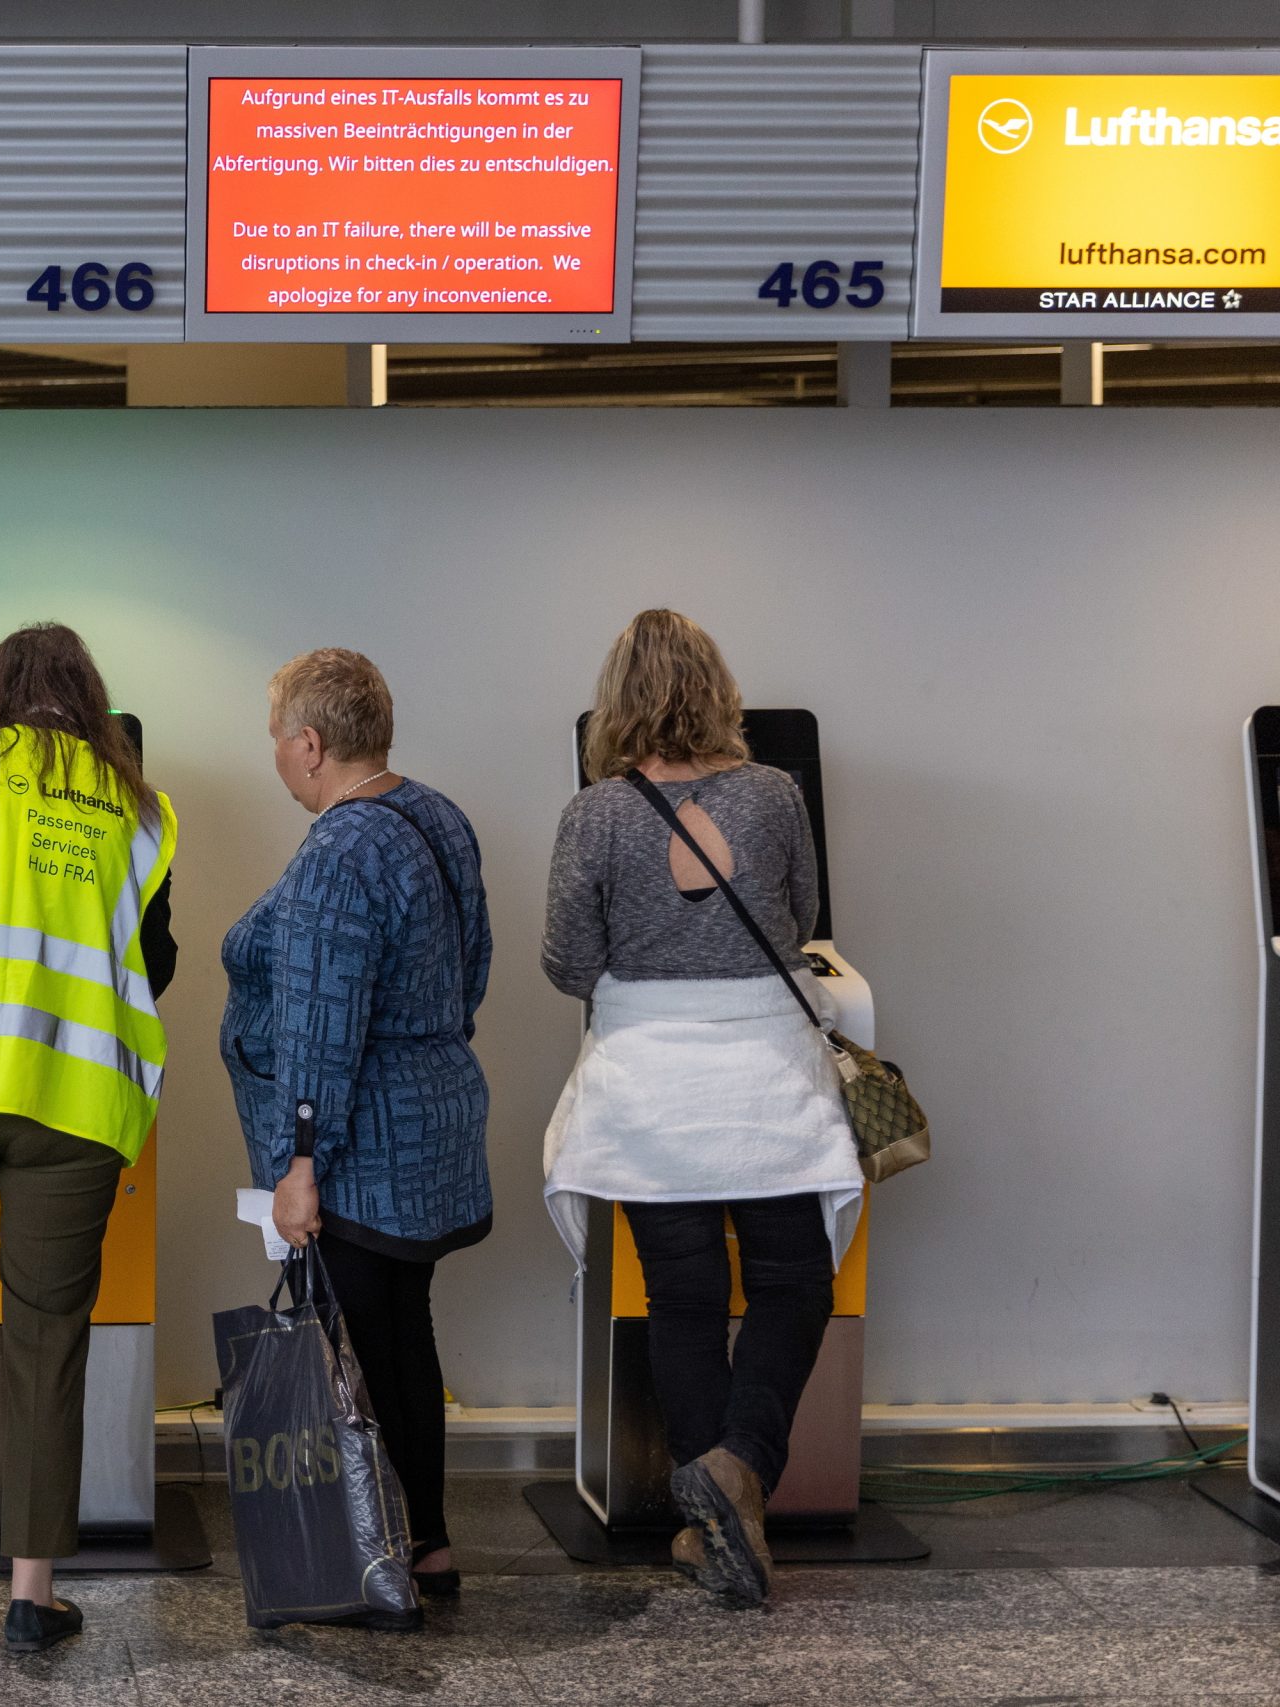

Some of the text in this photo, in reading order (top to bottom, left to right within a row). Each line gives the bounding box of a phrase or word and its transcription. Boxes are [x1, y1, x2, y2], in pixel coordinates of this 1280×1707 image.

[241, 89, 589, 109] Aufgrund eines IT-Ausfalls kommt es zu
[256, 122, 574, 143] massiven Beeinträchtigungen in der
[1064, 106, 1280, 147] Lufthansa
[212, 155, 614, 176] Abfertigung. Wir bitten dies zu entschuldigen.
[233, 221, 592, 240] Due to an IT failure, there will be massive
[241, 254, 581, 275] disruptions in check-in / operation. We
[1060, 242, 1266, 265] lufthansa.com
[26, 262, 155, 311] 466
[267, 286, 552, 308] apologize for any inconvenience.
[757, 261, 885, 309] 465
[1039, 291, 1216, 309] STAR ALLIANCE
[41, 783, 124, 817] Lufthansa
[27, 808, 107, 840] Passenger
[32, 833, 96, 860] Services
[28, 854, 95, 885] Hub FRA
[233, 1425, 342, 1492] BOSS
